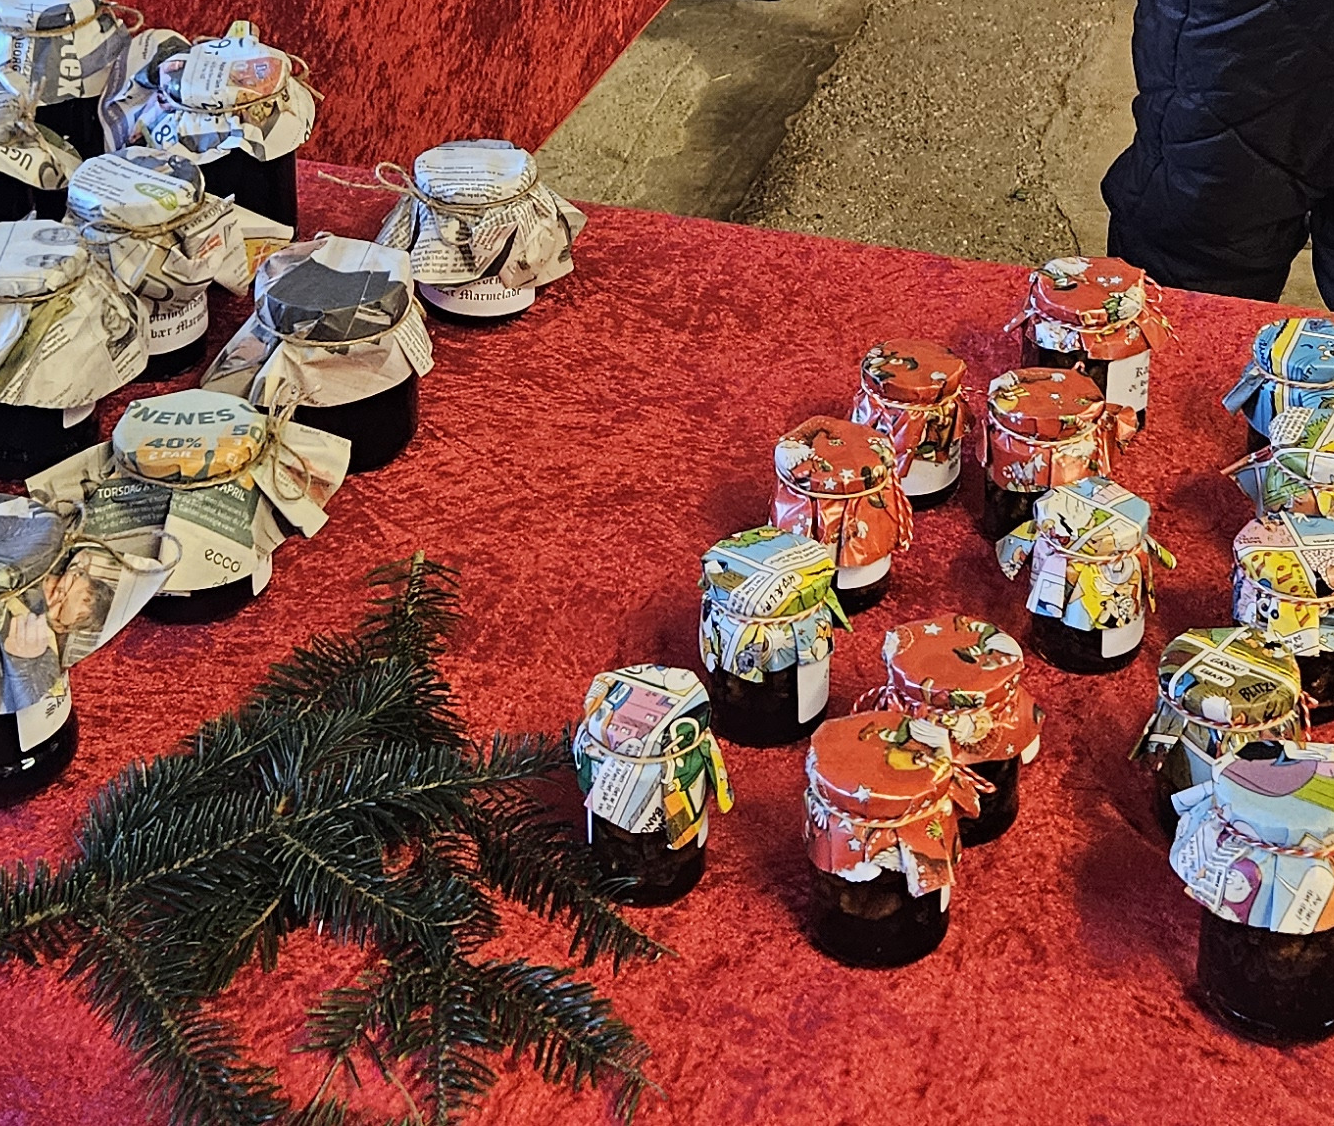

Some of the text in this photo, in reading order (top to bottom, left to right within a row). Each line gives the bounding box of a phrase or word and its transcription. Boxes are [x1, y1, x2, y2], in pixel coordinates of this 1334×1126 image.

[458, 286, 522, 302] Marmelade
[144, 436, 203, 450] 40%
[204, 547, 242, 573] ecco
